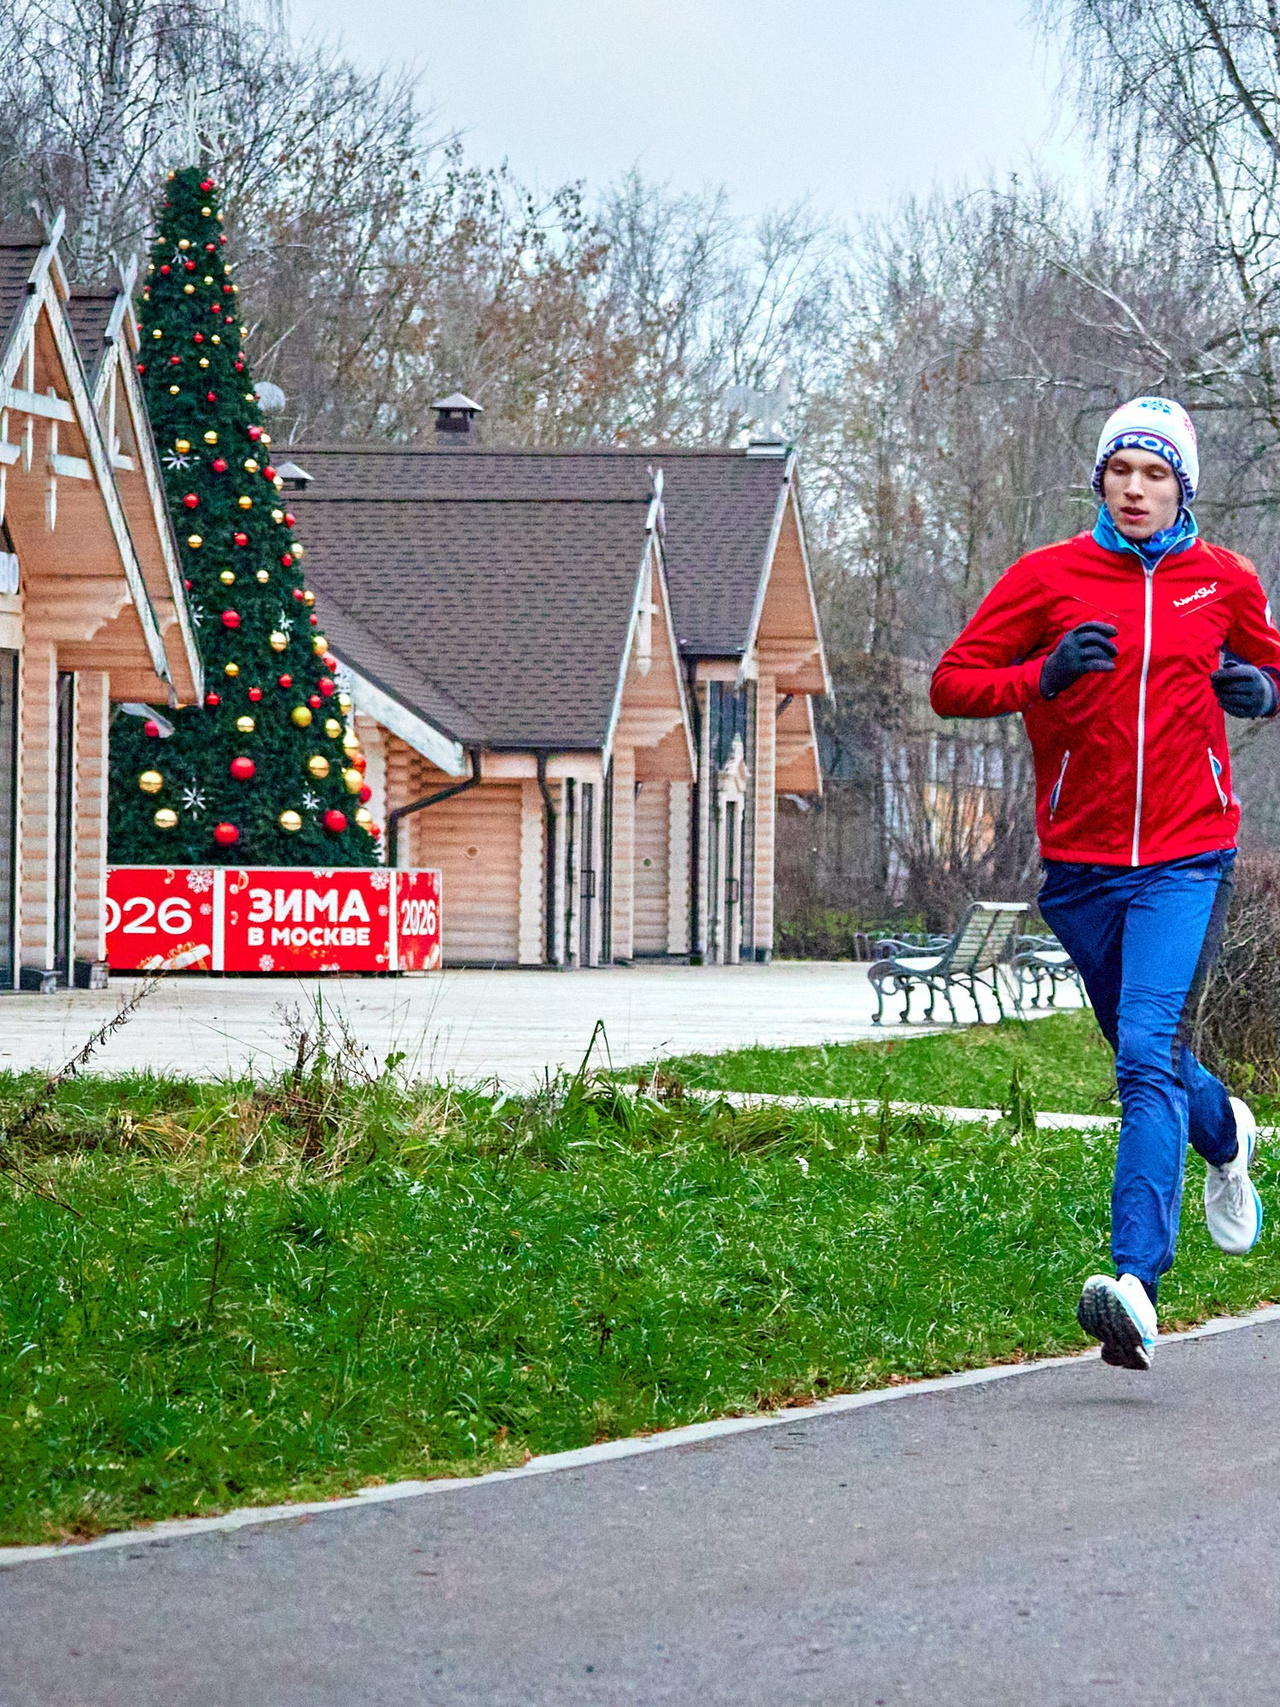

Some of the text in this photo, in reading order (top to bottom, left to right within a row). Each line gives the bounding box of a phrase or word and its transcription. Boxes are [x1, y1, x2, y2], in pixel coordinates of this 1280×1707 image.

[247, 888, 371, 923] ЗИМА
[401, 899, 436, 936] 2026
[247, 926, 371, 946] В МОСКВЕ
